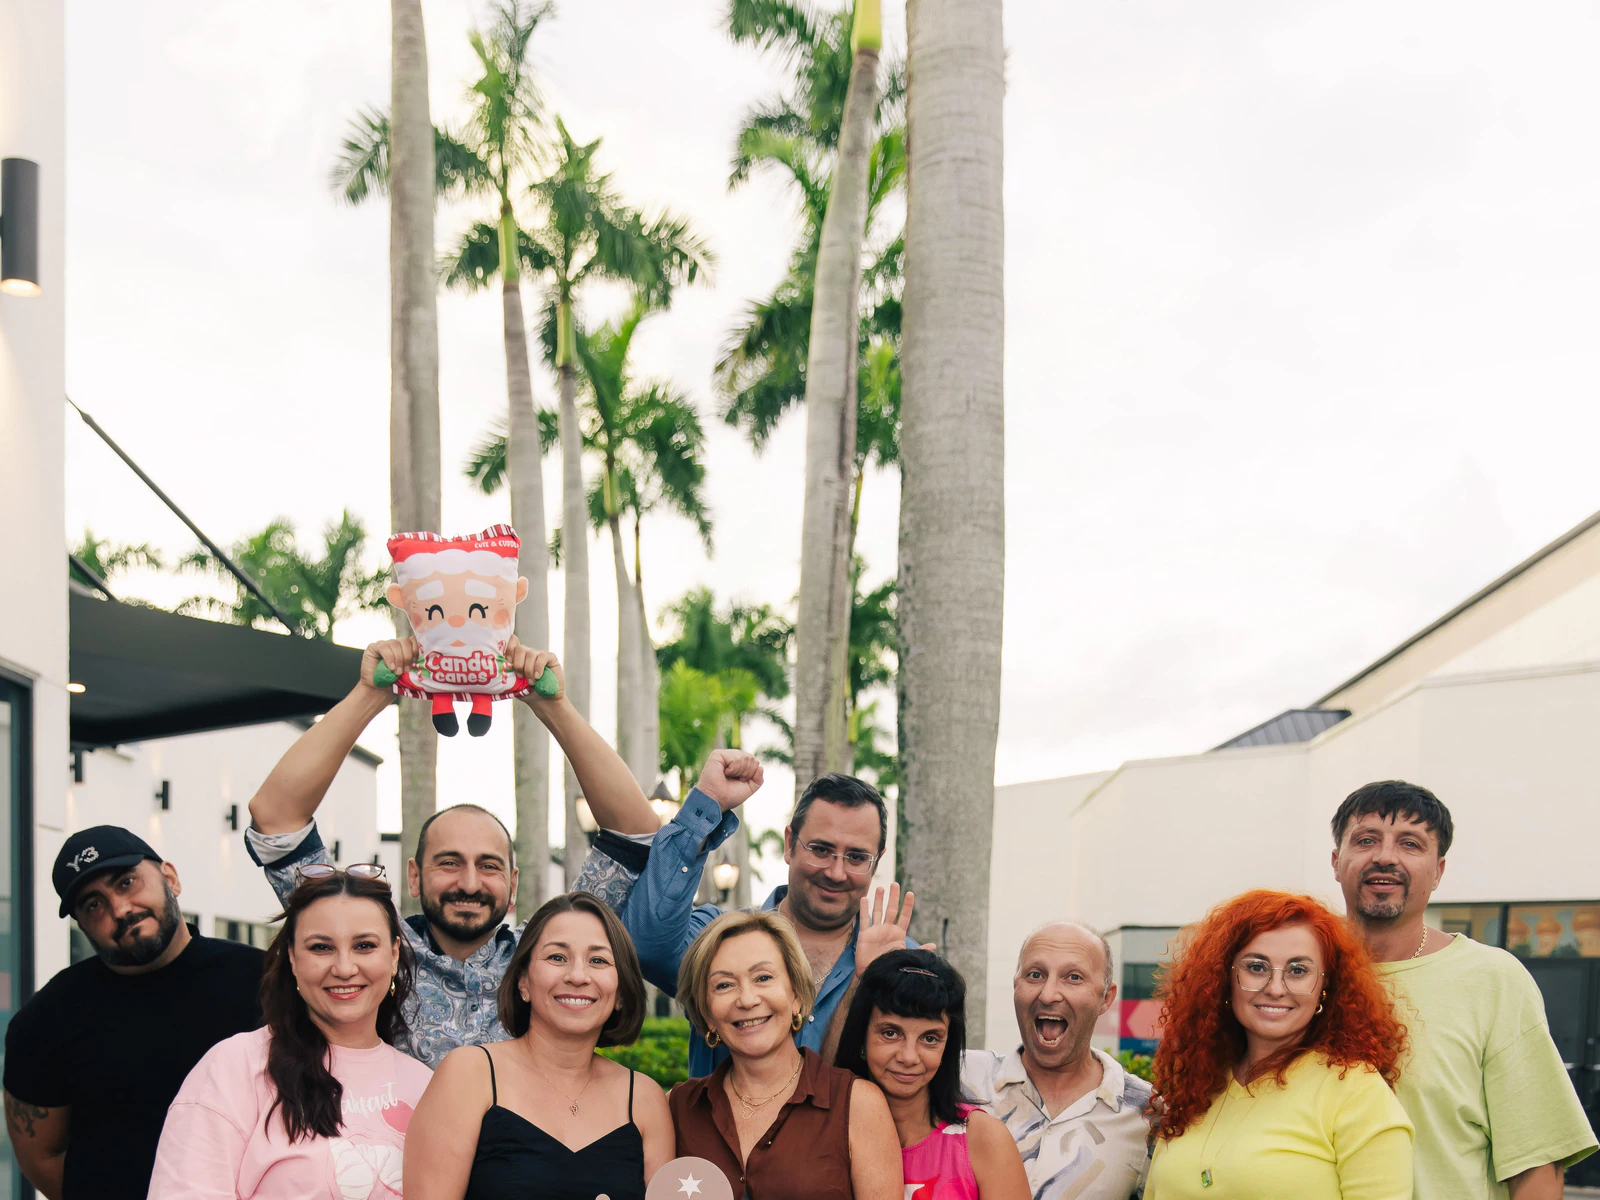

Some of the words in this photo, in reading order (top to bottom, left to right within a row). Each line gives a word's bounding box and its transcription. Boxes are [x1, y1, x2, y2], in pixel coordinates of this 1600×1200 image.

[474, 541, 489, 549] CUTE
[427, 652, 495, 676] Candy
[435, 671, 488, 683] canes
[66, 846, 99, 872] Y-3
